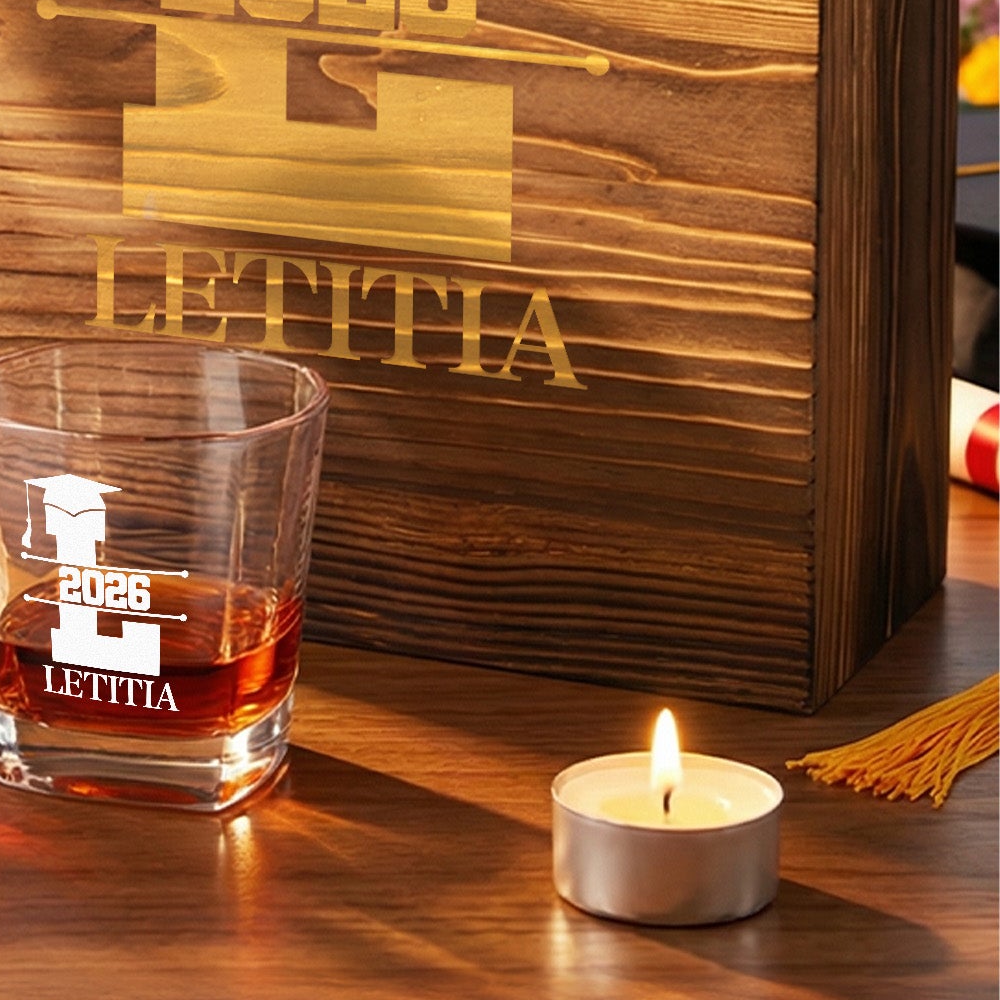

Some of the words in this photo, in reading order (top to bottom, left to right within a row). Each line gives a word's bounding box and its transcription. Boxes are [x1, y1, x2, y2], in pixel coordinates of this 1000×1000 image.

[85, 234, 588, 390] LETITIA
[58, 566, 151, 611] 2026
[42, 664, 180, 711] LETITIA
